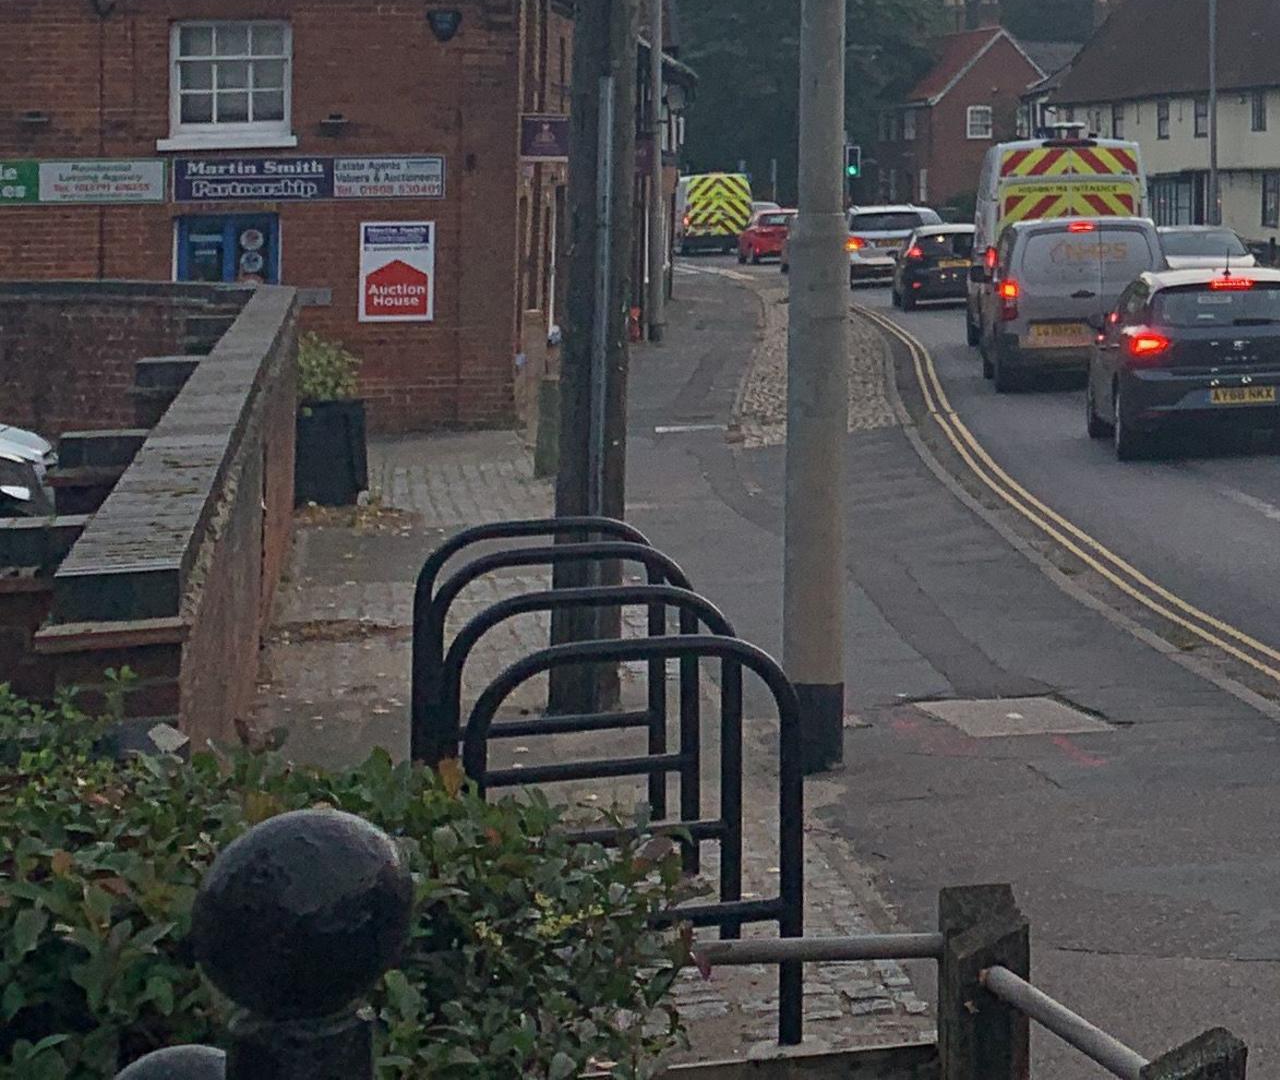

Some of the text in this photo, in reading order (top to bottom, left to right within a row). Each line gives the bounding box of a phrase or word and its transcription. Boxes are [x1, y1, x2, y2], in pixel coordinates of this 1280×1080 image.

[186, 159, 324, 175] Martin Smith
[335, 161, 401, 173] Estate Agents
[335, 172, 441, 183] Valuers & Auctioneers
[191, 178, 319, 198] Partnership
[1018, 185, 1052, 193] HIGHWAY
[368, 283, 426, 295] Auction
[373, 295, 420, 307] House
